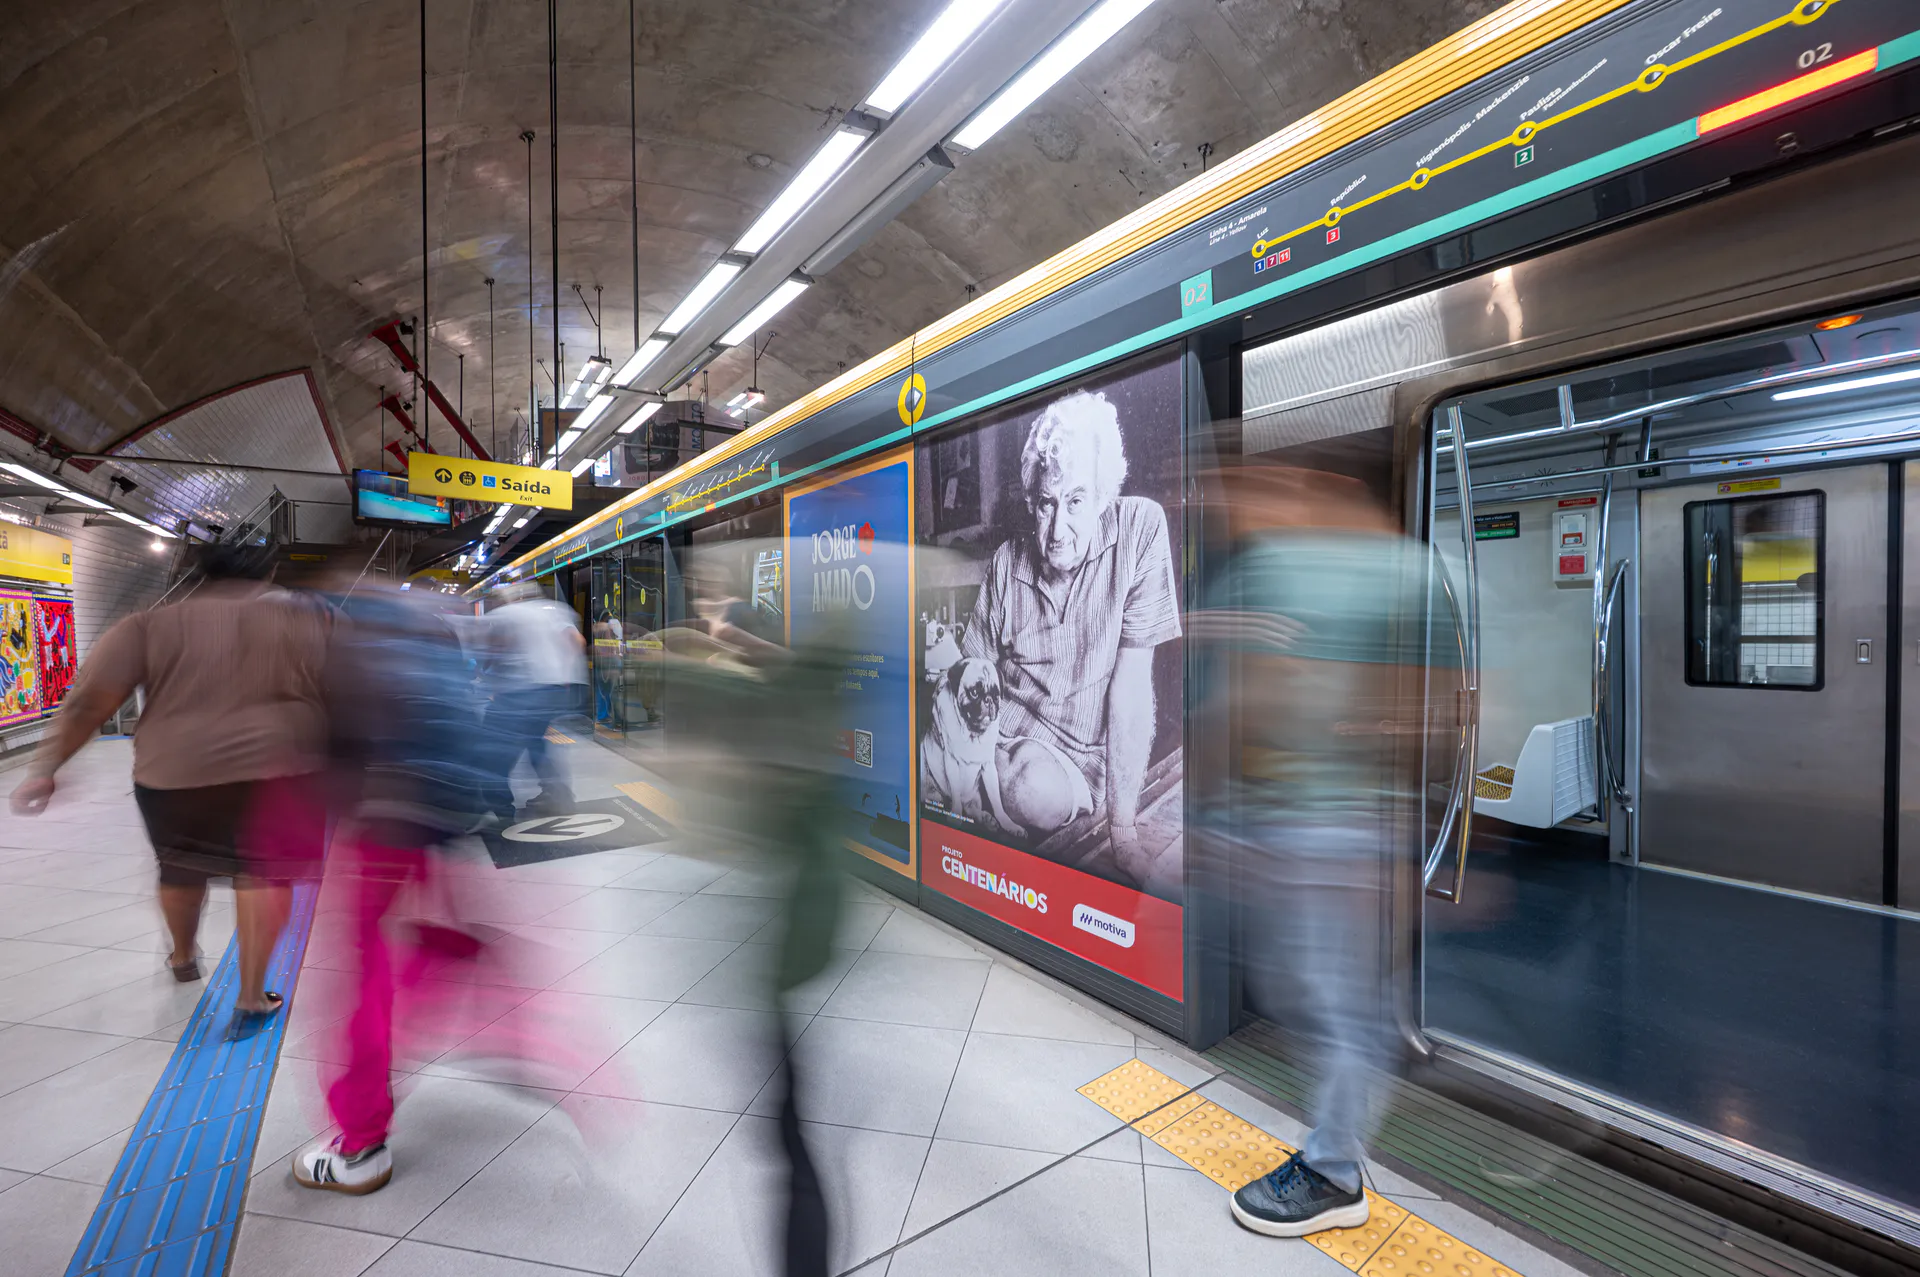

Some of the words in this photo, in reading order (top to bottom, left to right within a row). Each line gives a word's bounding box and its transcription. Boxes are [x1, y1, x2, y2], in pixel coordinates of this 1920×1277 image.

[1645, 36, 1682, 66] Oscar
[1682, 7, 1723, 39] Freire
[1797, 42, 1833, 69] 02
[1542, 57, 1608, 112] Pernambucanas
[1519, 87, 1562, 121] Paulista
[1415, 121, 1471, 168] Higienópolis
[1475, 75, 1530, 120] Mackenzie
[1520, 151, 1528, 162] 2
[1330, 174, 1367, 206] República
[1209, 225, 1228, 239] Linha
[1228, 222, 1234, 230] 4
[1238, 206, 1268, 225] Amarela
[1209, 236, 1221, 246] Line
[1229, 224, 1248, 238] Yellow
[1256, 227, 1270, 240] Luz
[1184, 283, 1208, 307] 02
[501, 478, 551, 495] Saída
[812, 524, 857, 565] JORGE
[812, 564, 876, 612] AMADO
[941, 845, 963, 858] PROJETO
[941, 855, 1048, 914] CENTENÁRIOS
[1094, 918, 1127, 939] motiva
